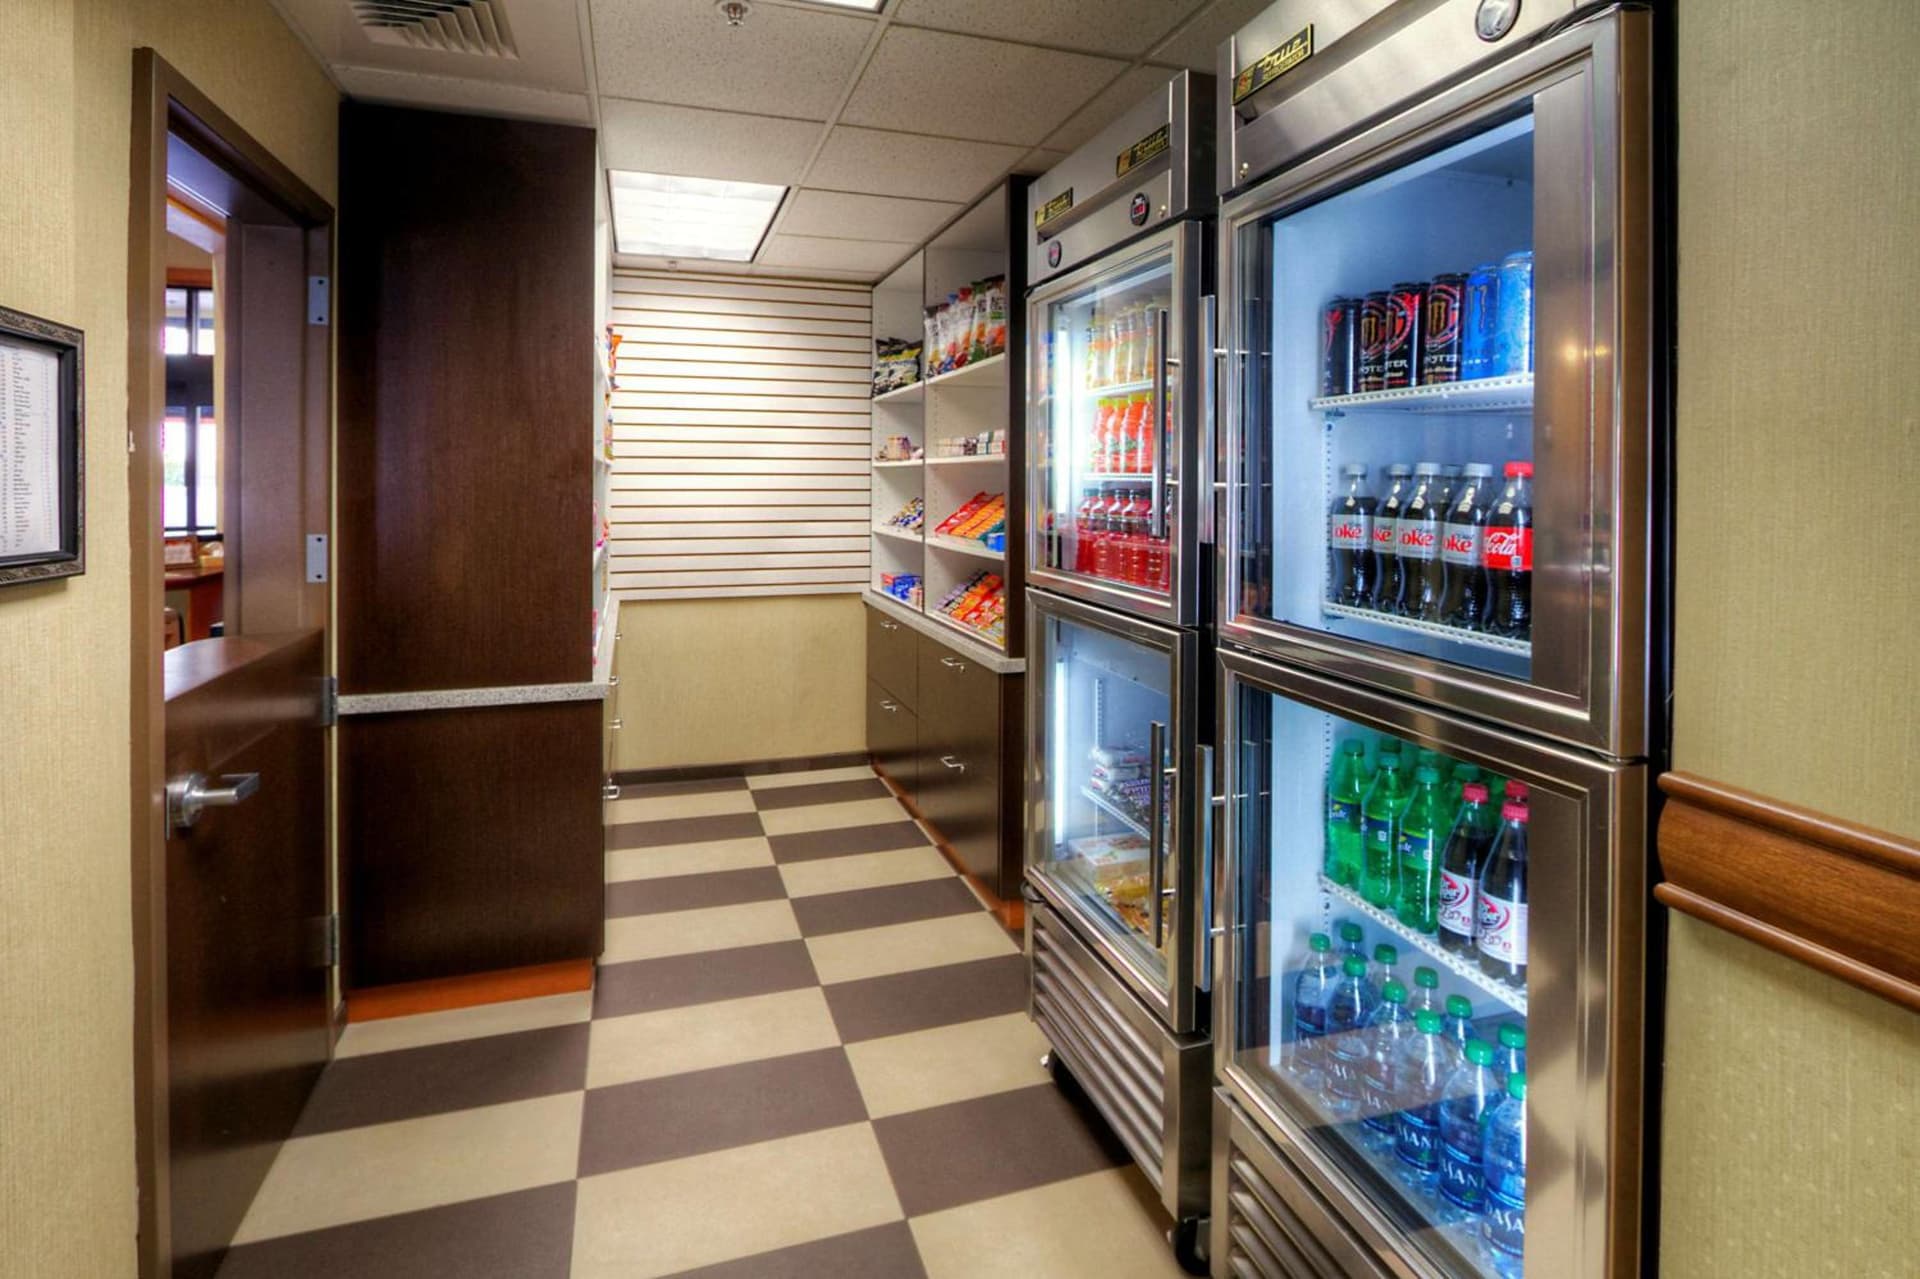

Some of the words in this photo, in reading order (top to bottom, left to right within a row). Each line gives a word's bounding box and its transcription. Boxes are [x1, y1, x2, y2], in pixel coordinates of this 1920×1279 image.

[1334, 523, 1362, 539] oke
[1372, 527, 1392, 543] ke
[1442, 532, 1473, 553] oke
